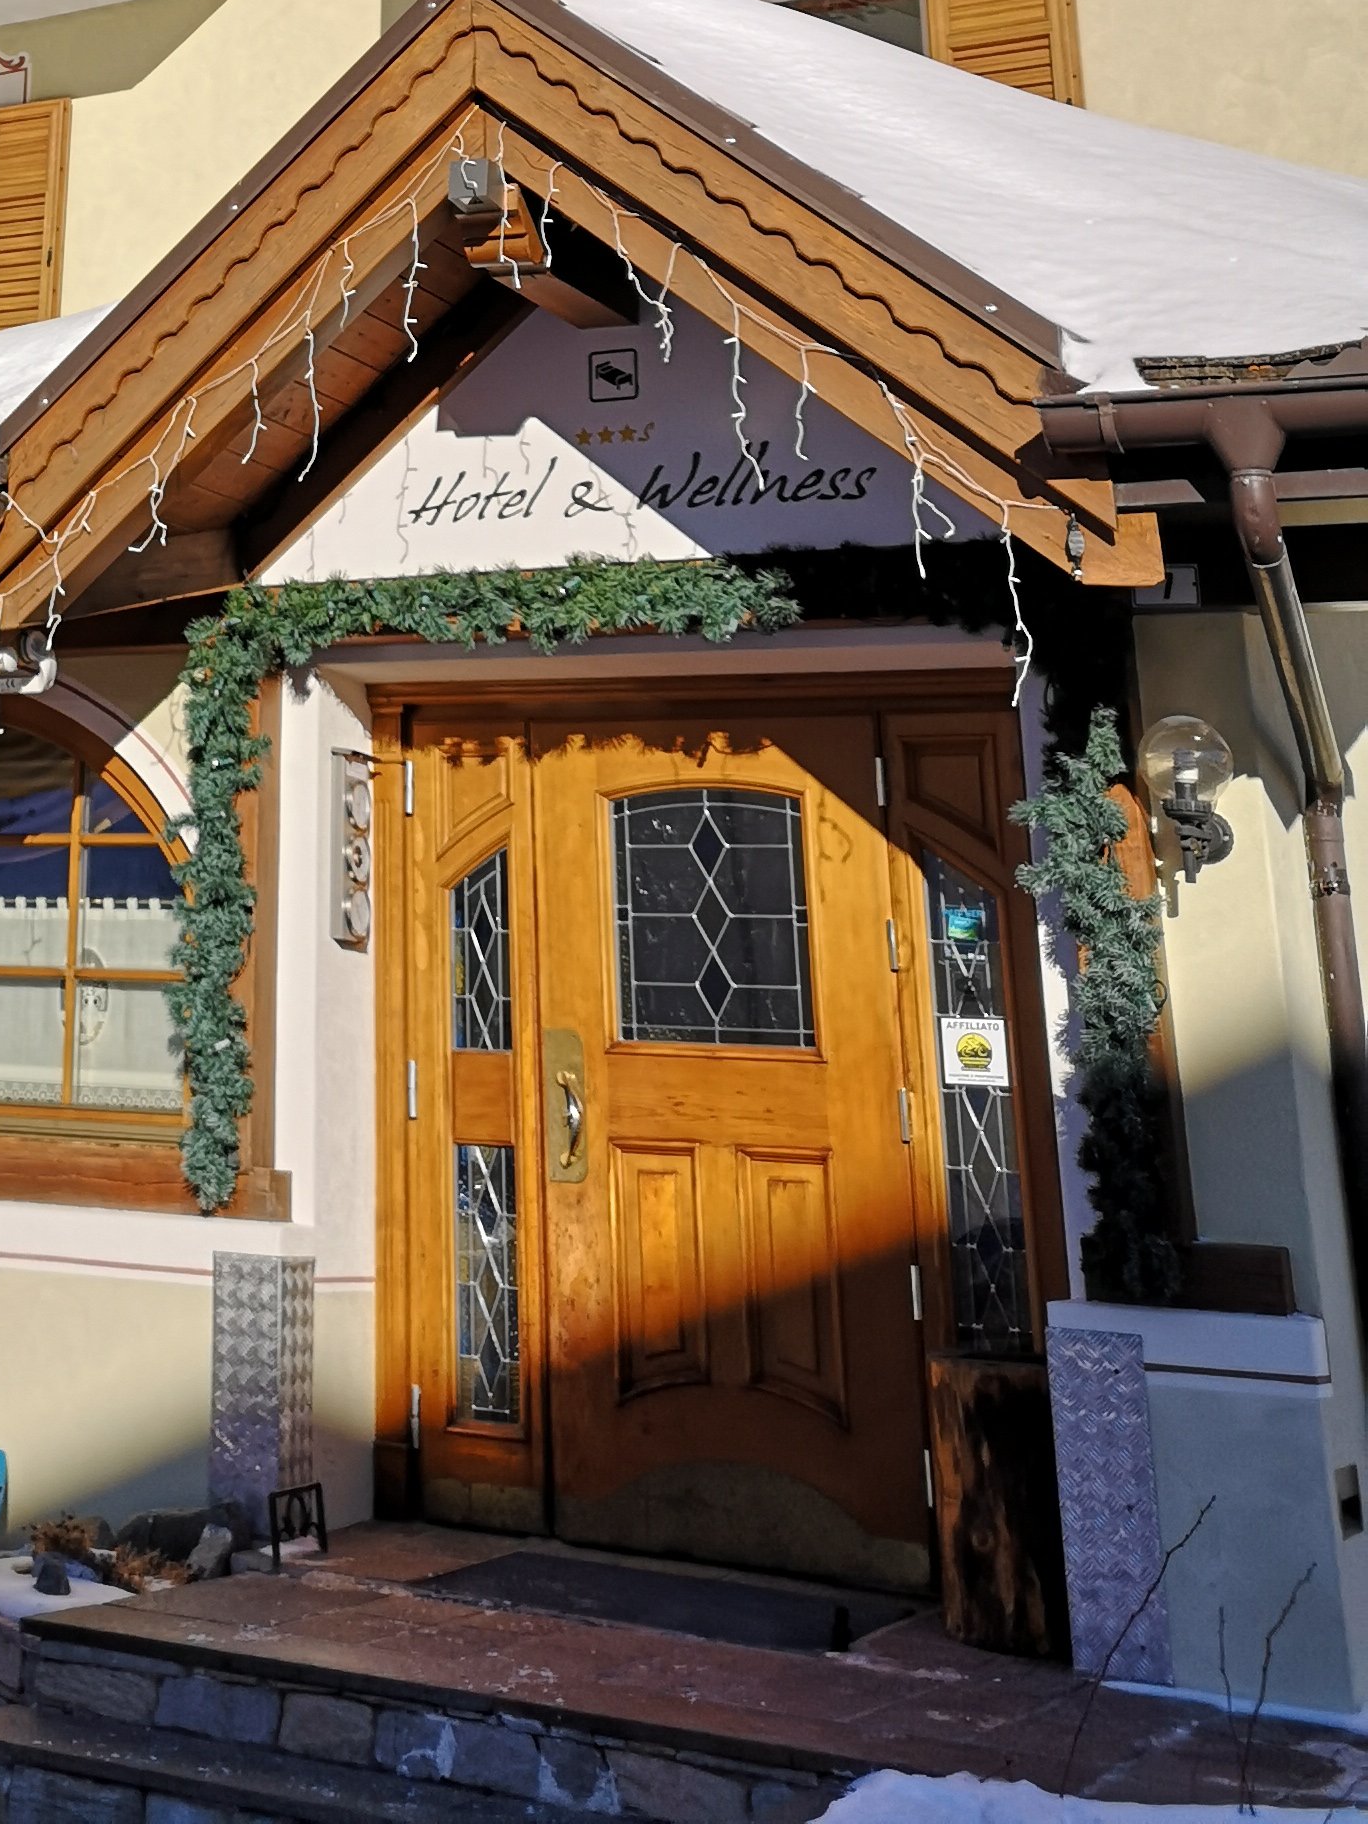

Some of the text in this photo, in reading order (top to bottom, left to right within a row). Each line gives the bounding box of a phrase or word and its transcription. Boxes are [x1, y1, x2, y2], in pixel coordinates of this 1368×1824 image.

[408, 440, 879, 526] Hotel & Wellness
[946, 1021, 1000, 1032] AFFILIATO
